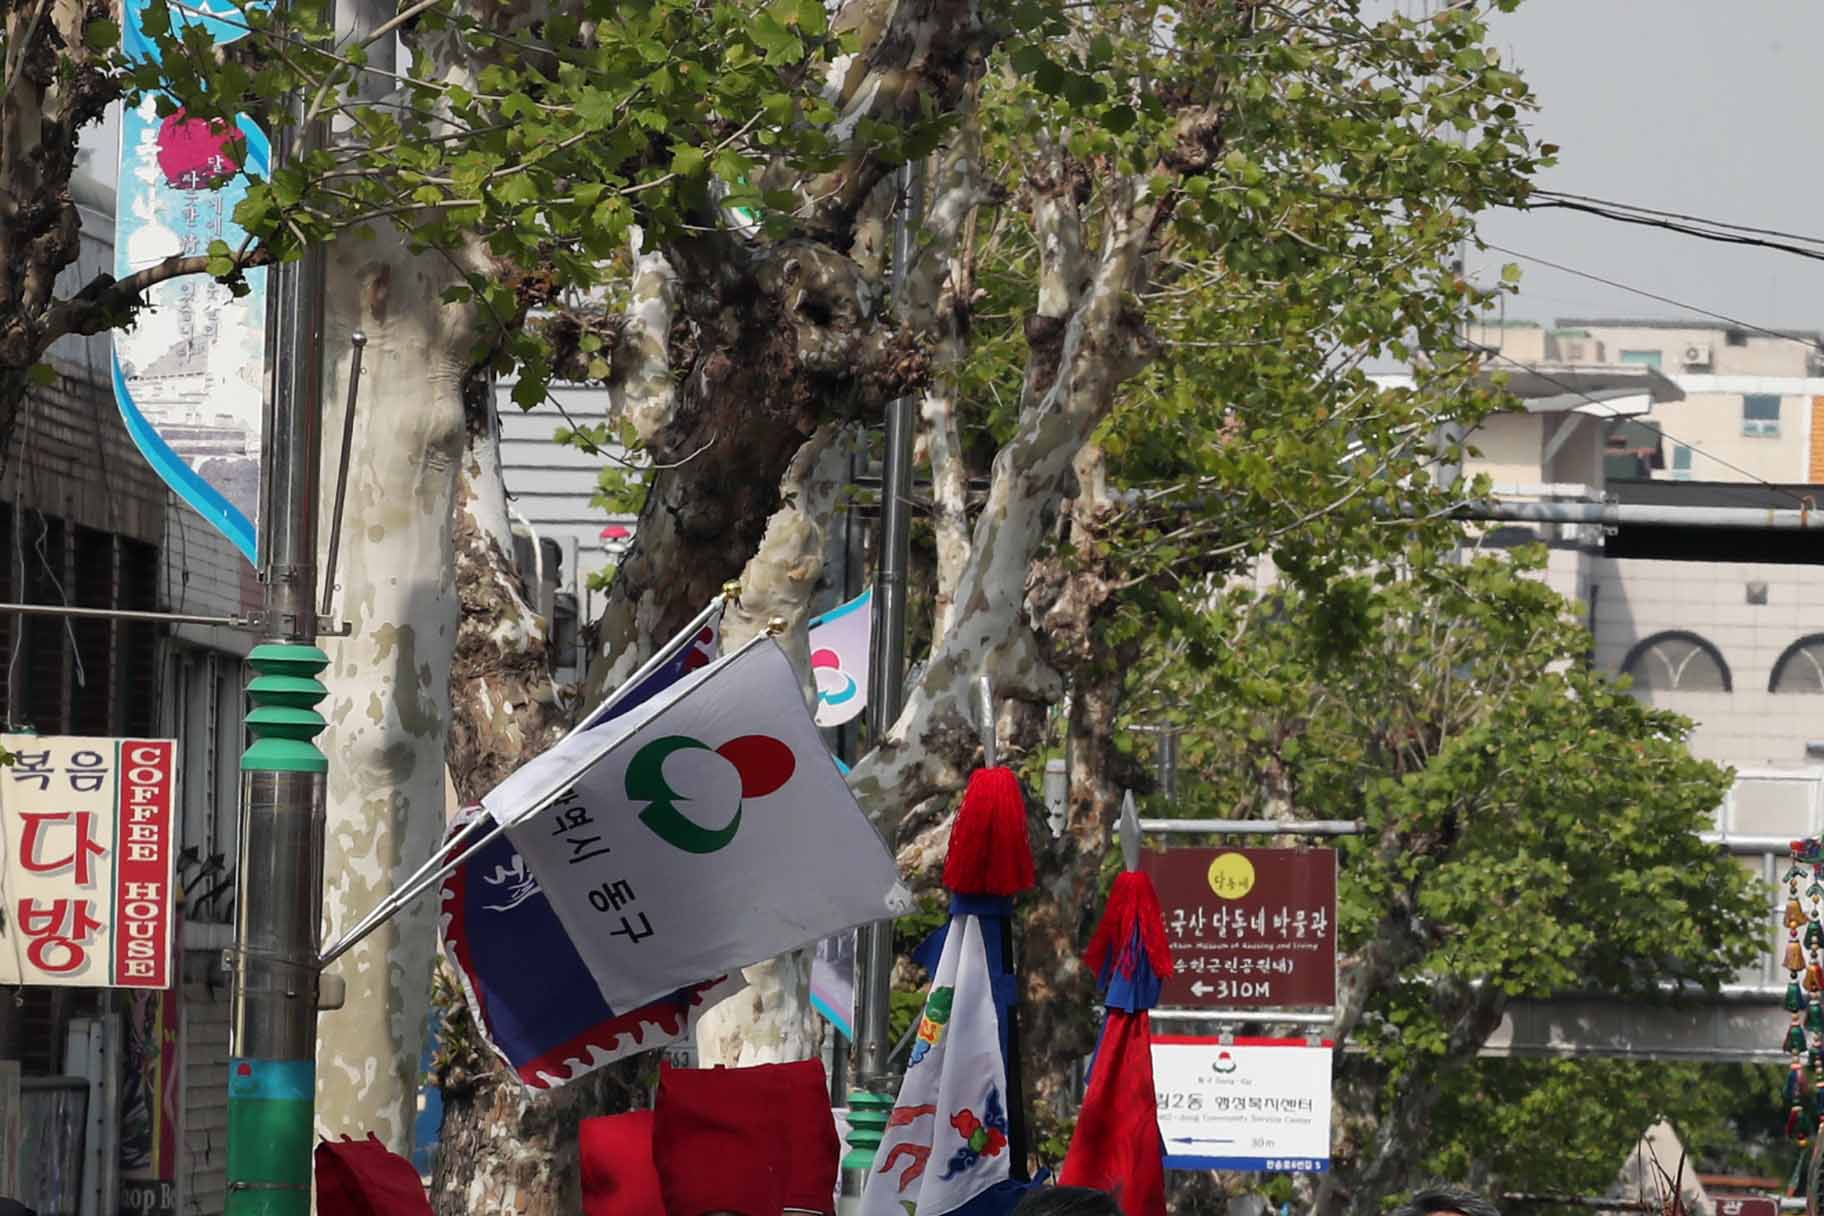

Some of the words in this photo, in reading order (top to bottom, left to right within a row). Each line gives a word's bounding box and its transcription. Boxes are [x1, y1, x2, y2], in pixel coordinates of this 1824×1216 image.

[11, 750, 108, 792] 복음
[127, 747, 164, 862] COFFEE
[18, 811, 108, 973] 다방
[588, 879, 654, 944] 동구
[124, 882, 161, 977] HOUSE
[1162, 906, 1207, 938] 국산
[1212, 906, 1266, 938] 달동네
[1272, 906, 1328, 938] 박물관
[1217, 980, 1271, 998] 310M
[1214, 1095, 1313, 1113] 행정복지센터
